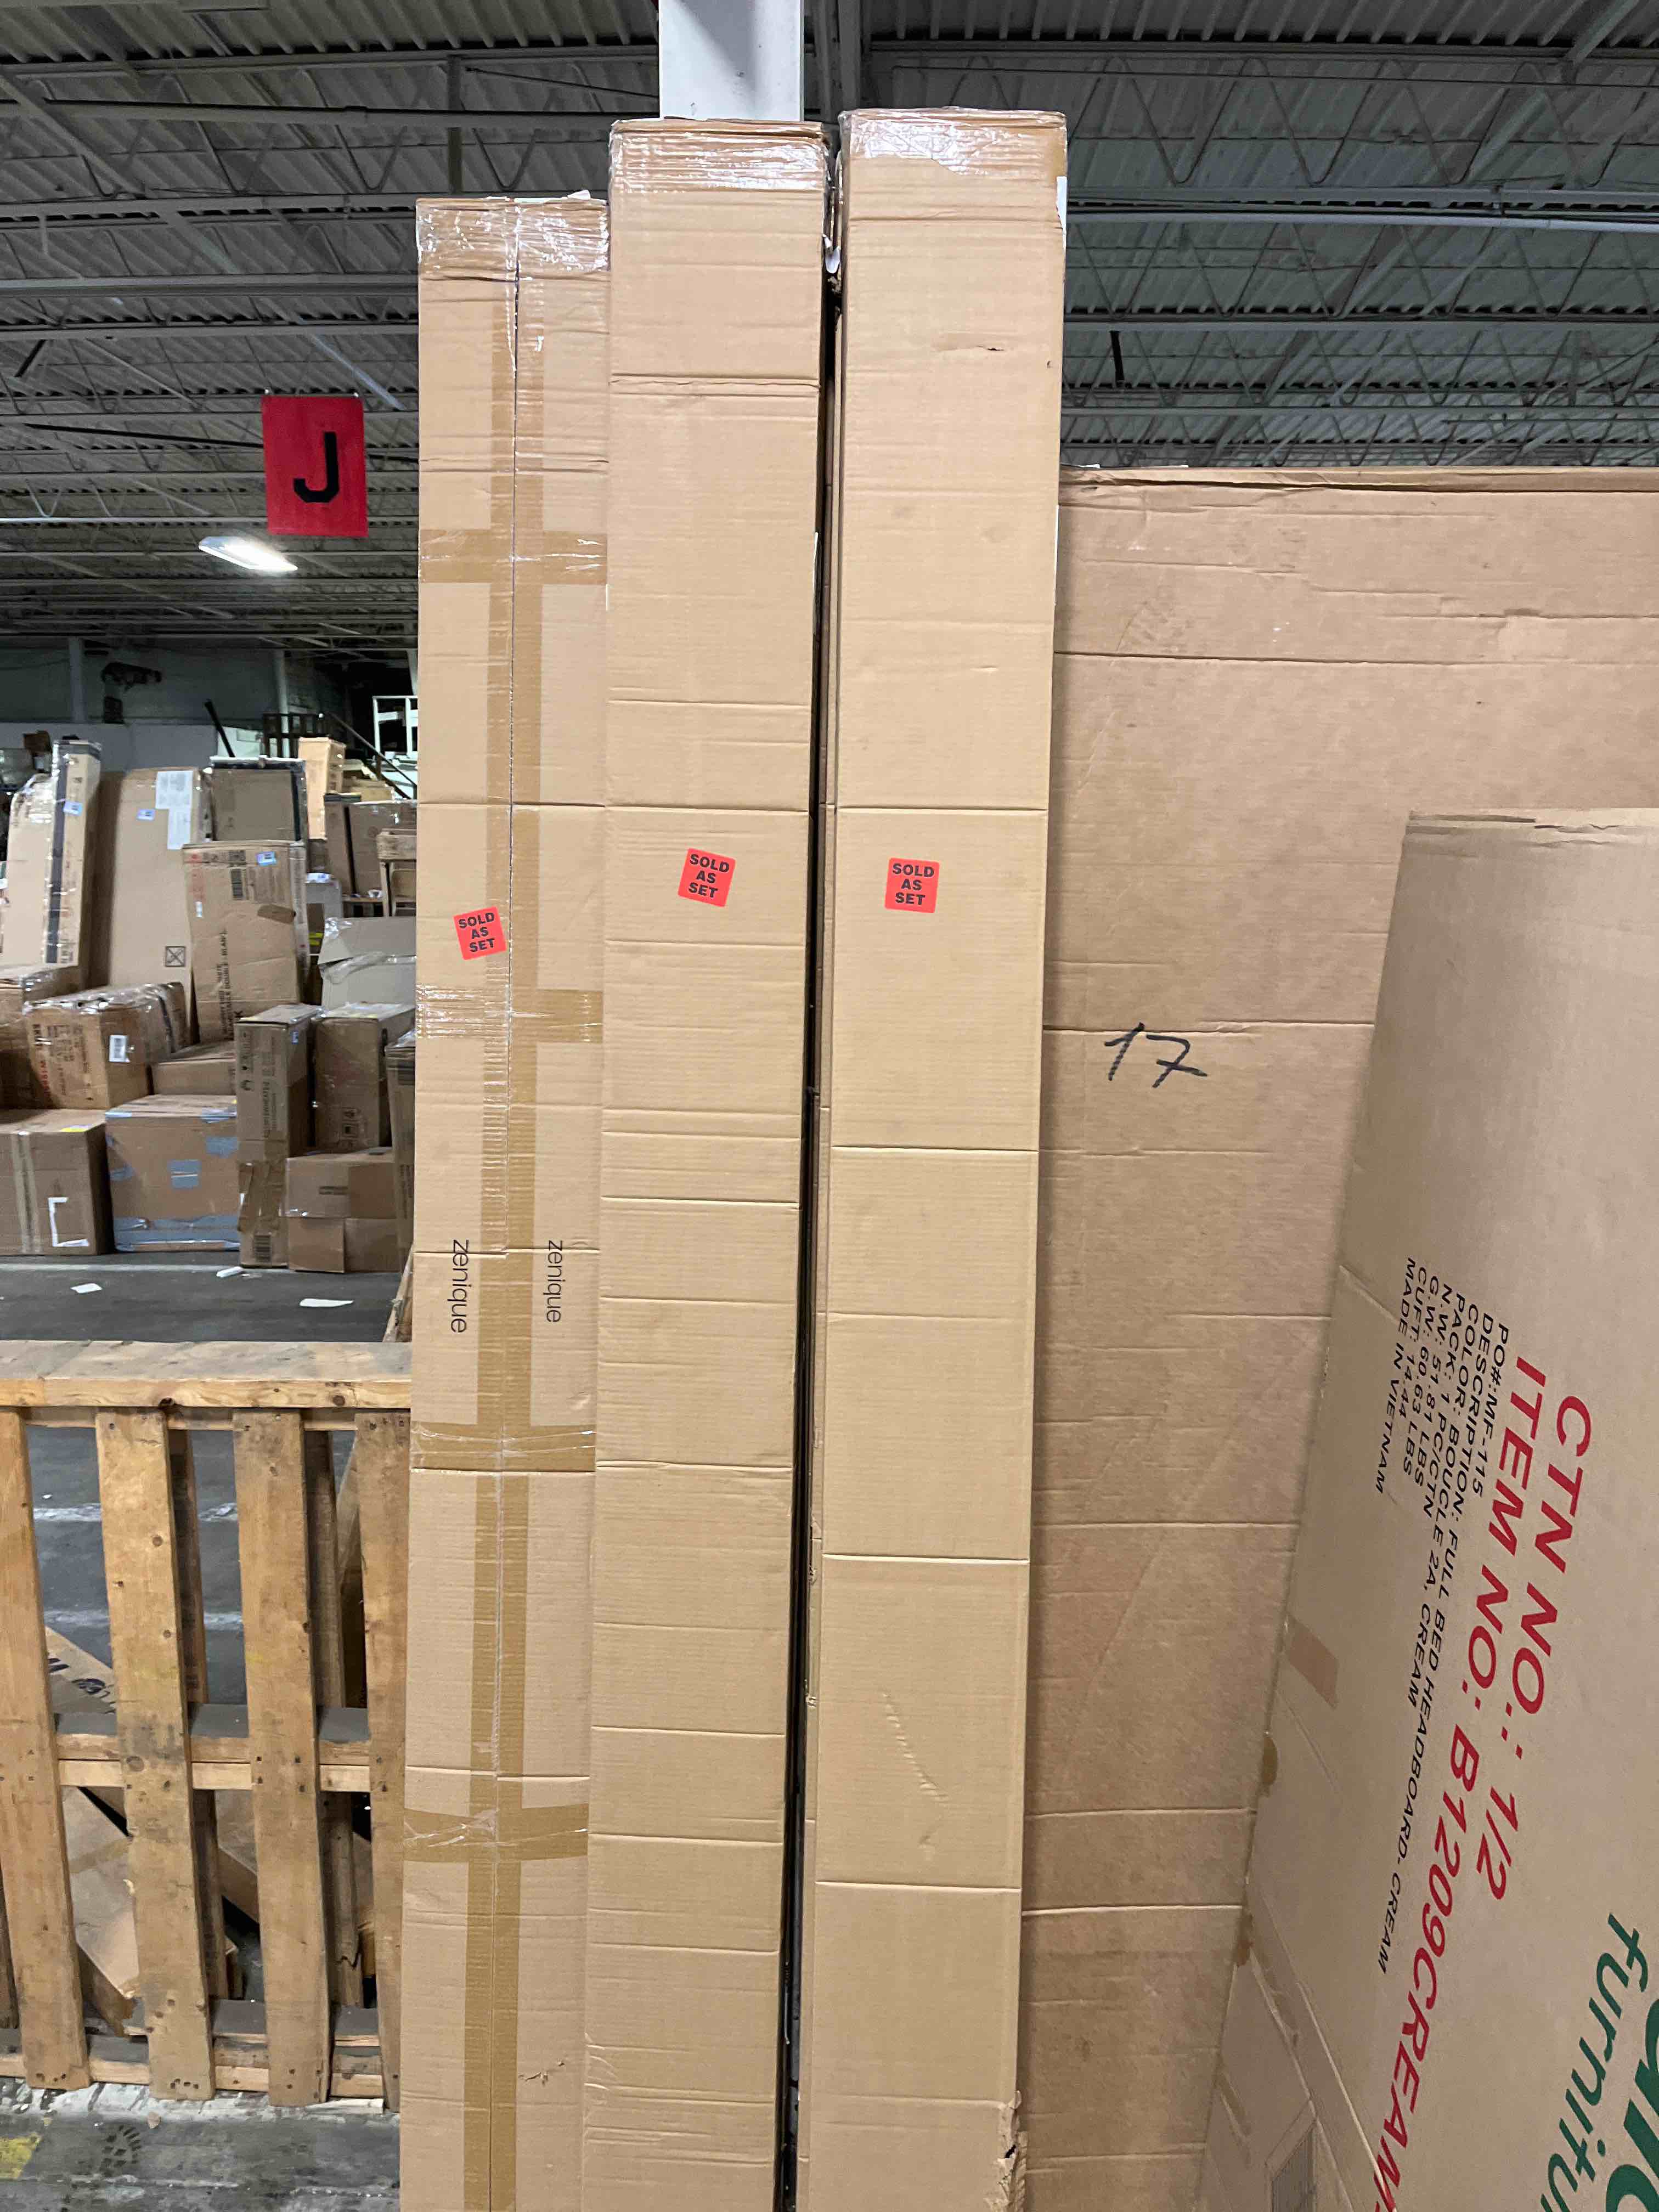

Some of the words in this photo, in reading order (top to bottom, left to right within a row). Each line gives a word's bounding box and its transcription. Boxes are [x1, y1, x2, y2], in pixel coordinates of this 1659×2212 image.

[293, 431, 340, 503] J
[688, 882, 718, 898] SET
[690, 854, 729, 872] SOLD
[696, 870, 716, 883] AS
[892, 863, 934, 877] SOLD
[901, 878, 922, 890] AS
[459, 912, 494, 928] SOLD
[472, 927, 489, 939] AS
[895, 892, 926, 905] SET
[470, 938, 495, 952] SET
[1104, 1022, 1208, 1088] 17
[447, 1239, 472, 1333] zenique
[543, 1240, 566, 1323] zenique
[1396, 1258, 1416, 1336] MADE
[1409, 1266, 1427, 1343] CUFT:
[1422, 1275, 1439, 1338] G.W:
[1435, 1283, 1453, 1346] N.W:
[1393, 1342, 1405, 1370] IN
[1444, 1293, 1466, 1380] PACK:
[1453, 1304, 1479, 1417] COLOR:
[1398, 1354, 1415, 1419] 14.44
[1412, 1346, 1429, 1415] 60.63
[1424, 1355, 1442, 1424] 51.81
[1441, 1392, 1451, 1405] 1
[1473, 1323, 1509, 1498] PO#:MF-115
[1376, 1379, 1400, 1494] VIETNAM
[1402, 1420, 1419, 1476] LBS
[1452, 1313, 1494, 1522] DESCRIPTION:
[1414, 1430, 1430, 1487] LBS
[1423, 1412, 1447, 1519] PC/CTN
[1433, 1424, 1460, 1547] BOUCLE
[1488, 1356, 1547, 1557] ITEM
[1534, 1395, 1592, 1573] CTN
[1424, 1550, 1440, 1592] 2A,
[1438, 1528, 1458, 1600] FULL
[1408, 1603, 1431, 1708] CREAM
[1428, 1608, 1446, 1672] BED
[1476, 1786, 1519, 1900] 1/2
[1378, 1872, 1401, 1974] CREAM
[1373, 1723, 1480, 2212] B1209CREAM
